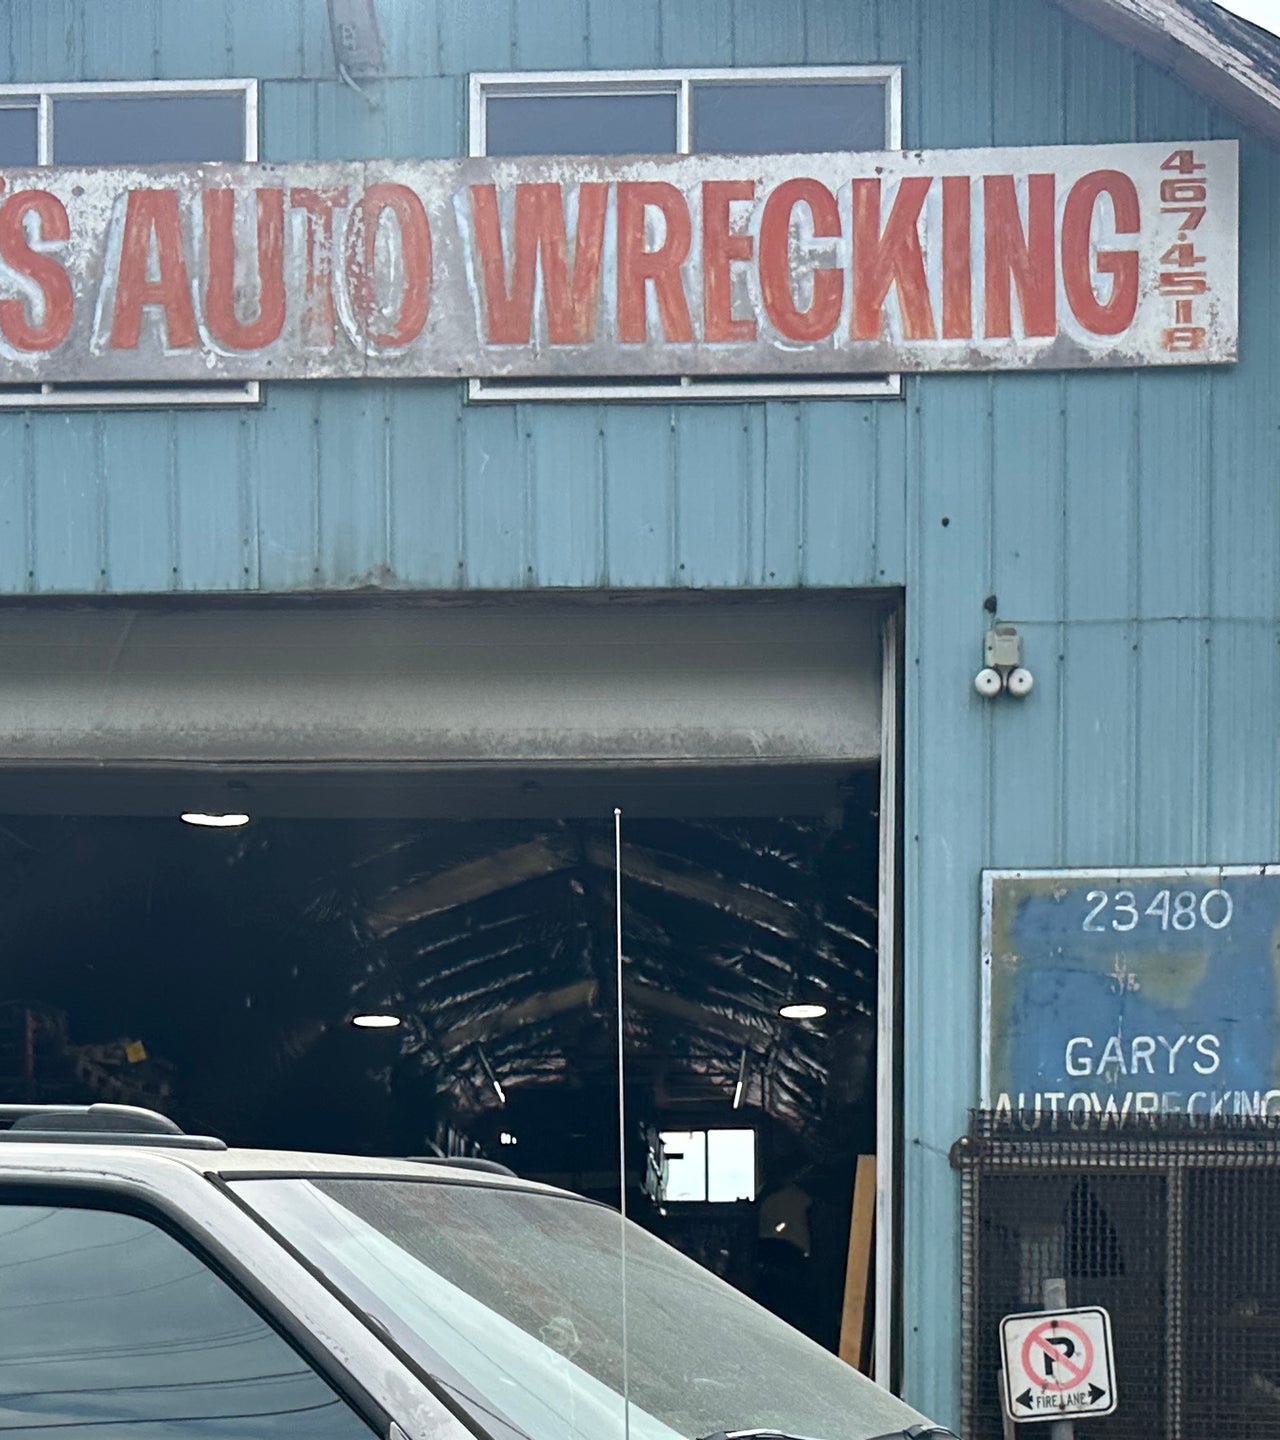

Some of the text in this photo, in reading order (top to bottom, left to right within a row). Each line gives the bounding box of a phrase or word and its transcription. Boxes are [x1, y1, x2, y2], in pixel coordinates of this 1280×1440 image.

[107, 182, 433, 352] AUTO
[466, 169, 1143, 348] WRECKING
[1081, 888, 1234, 933] 23480
[1065, 1034, 1221, 1077] GARY'S
[1036, 1394, 1058, 1409] FIRE
